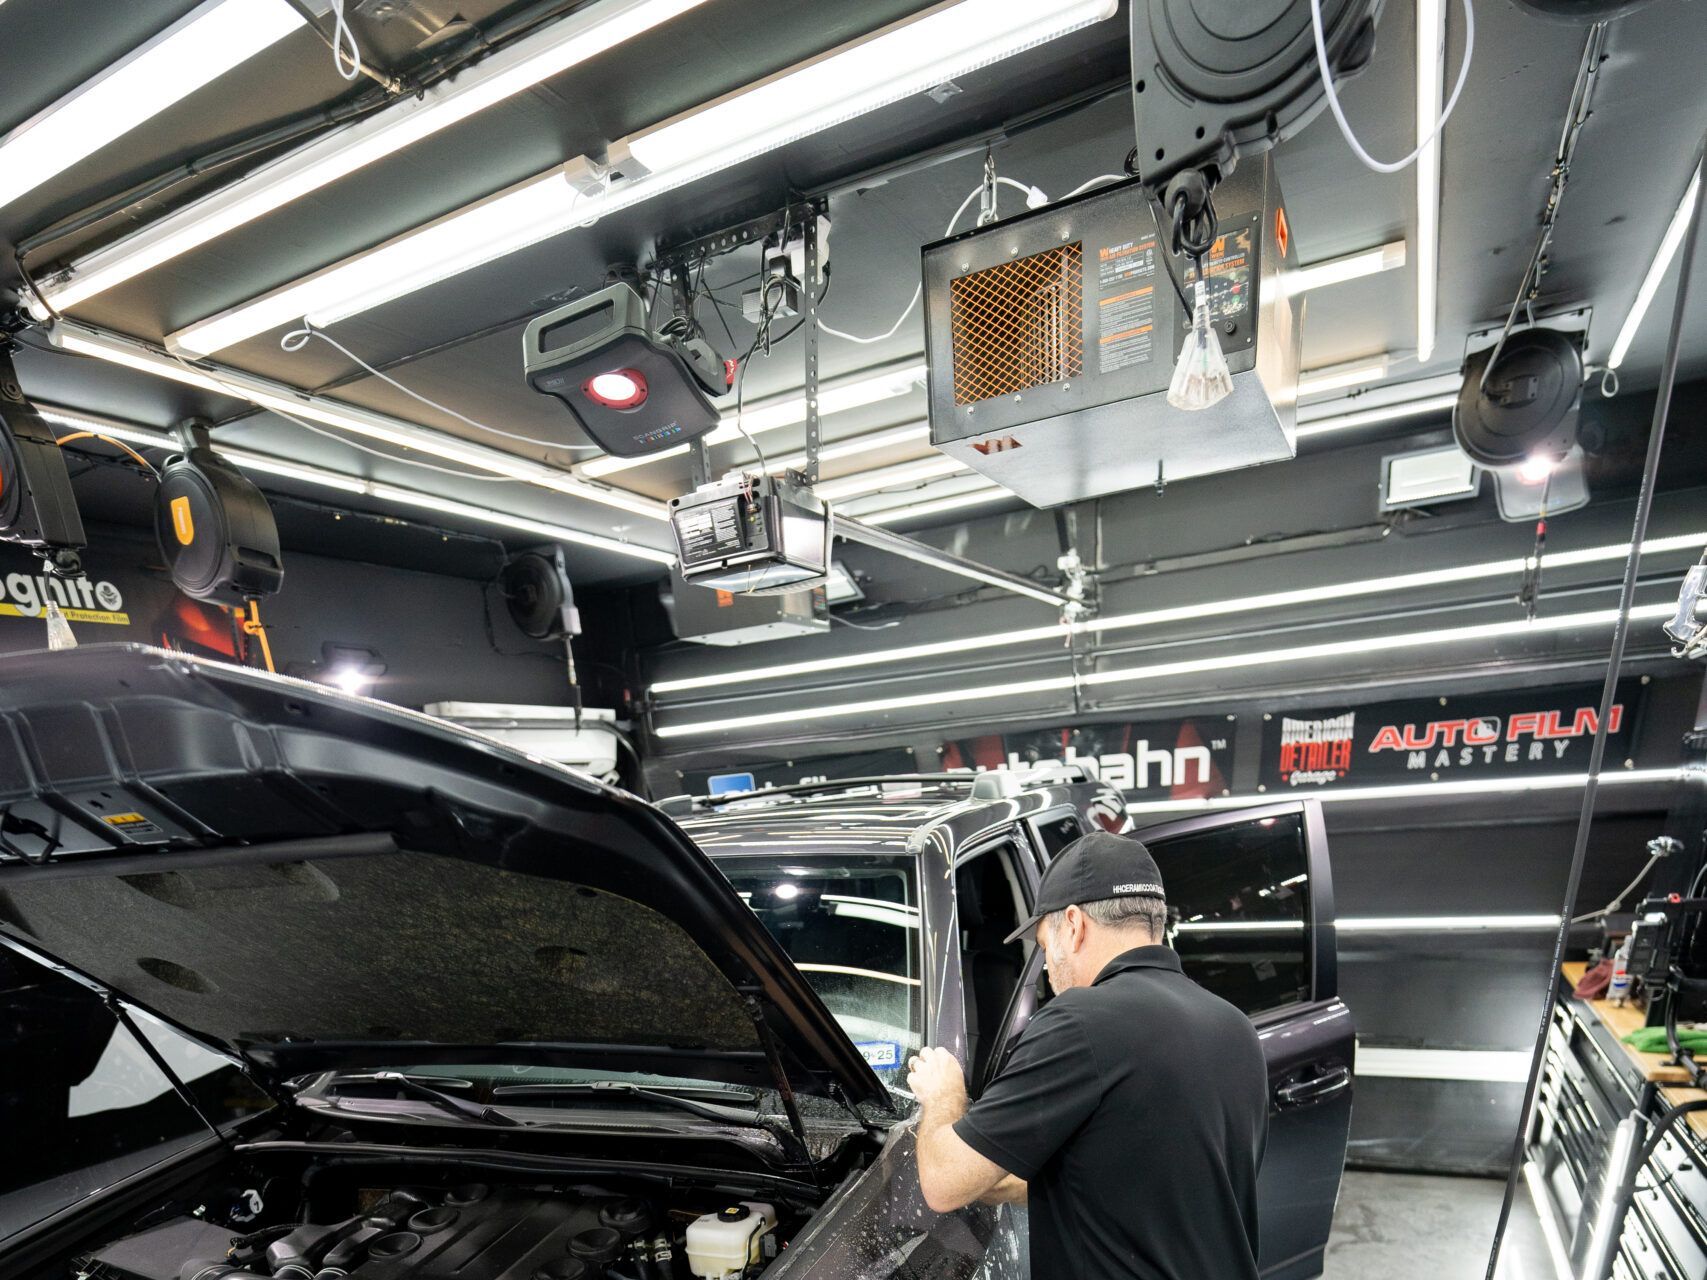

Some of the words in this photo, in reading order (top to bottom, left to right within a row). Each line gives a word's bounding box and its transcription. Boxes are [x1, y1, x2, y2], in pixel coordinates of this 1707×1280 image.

[1368, 716, 1500, 753] AUTO
[1506, 704, 1624, 742] FILM
[1280, 737, 1352, 771] DETAILER
[1407, 738, 1570, 770] MASTERY
